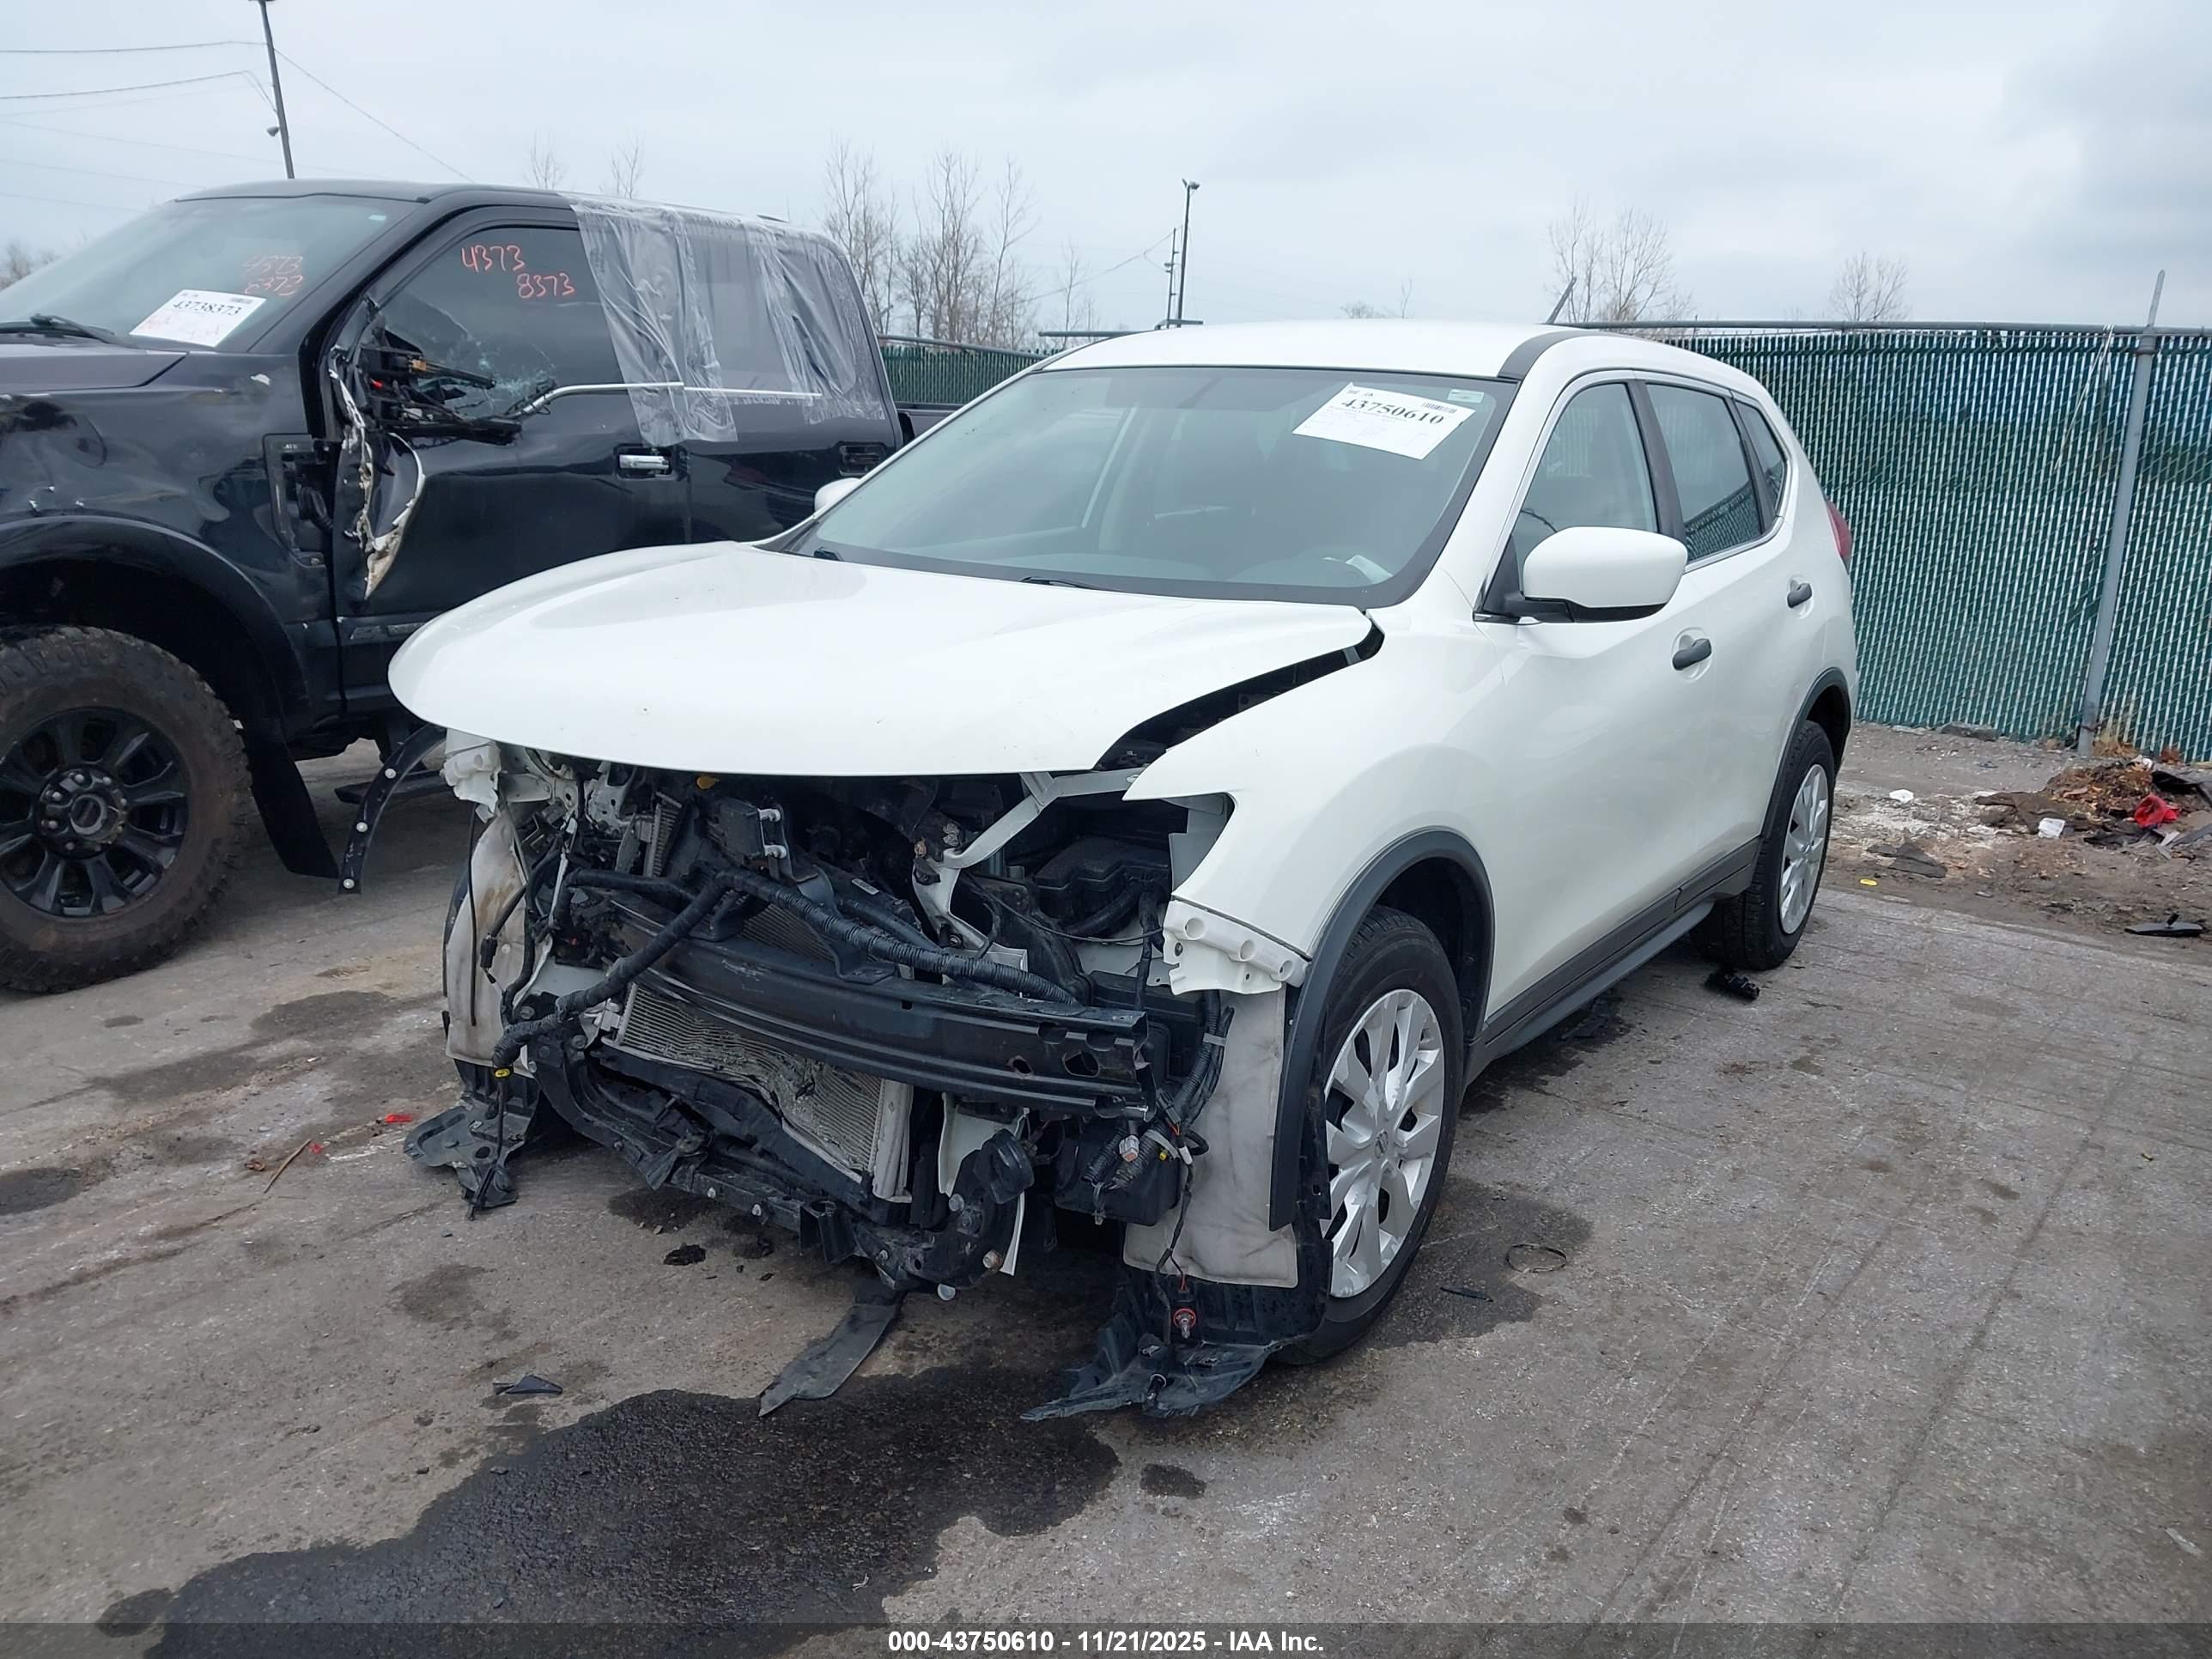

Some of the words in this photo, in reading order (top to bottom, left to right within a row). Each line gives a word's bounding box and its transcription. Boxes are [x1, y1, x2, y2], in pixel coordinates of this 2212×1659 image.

[461, 245, 526, 273] 4373
[517, 272, 575, 298] 8373
[173, 300, 242, 316] 43738373
[1341, 398, 1444, 424] 43750610
